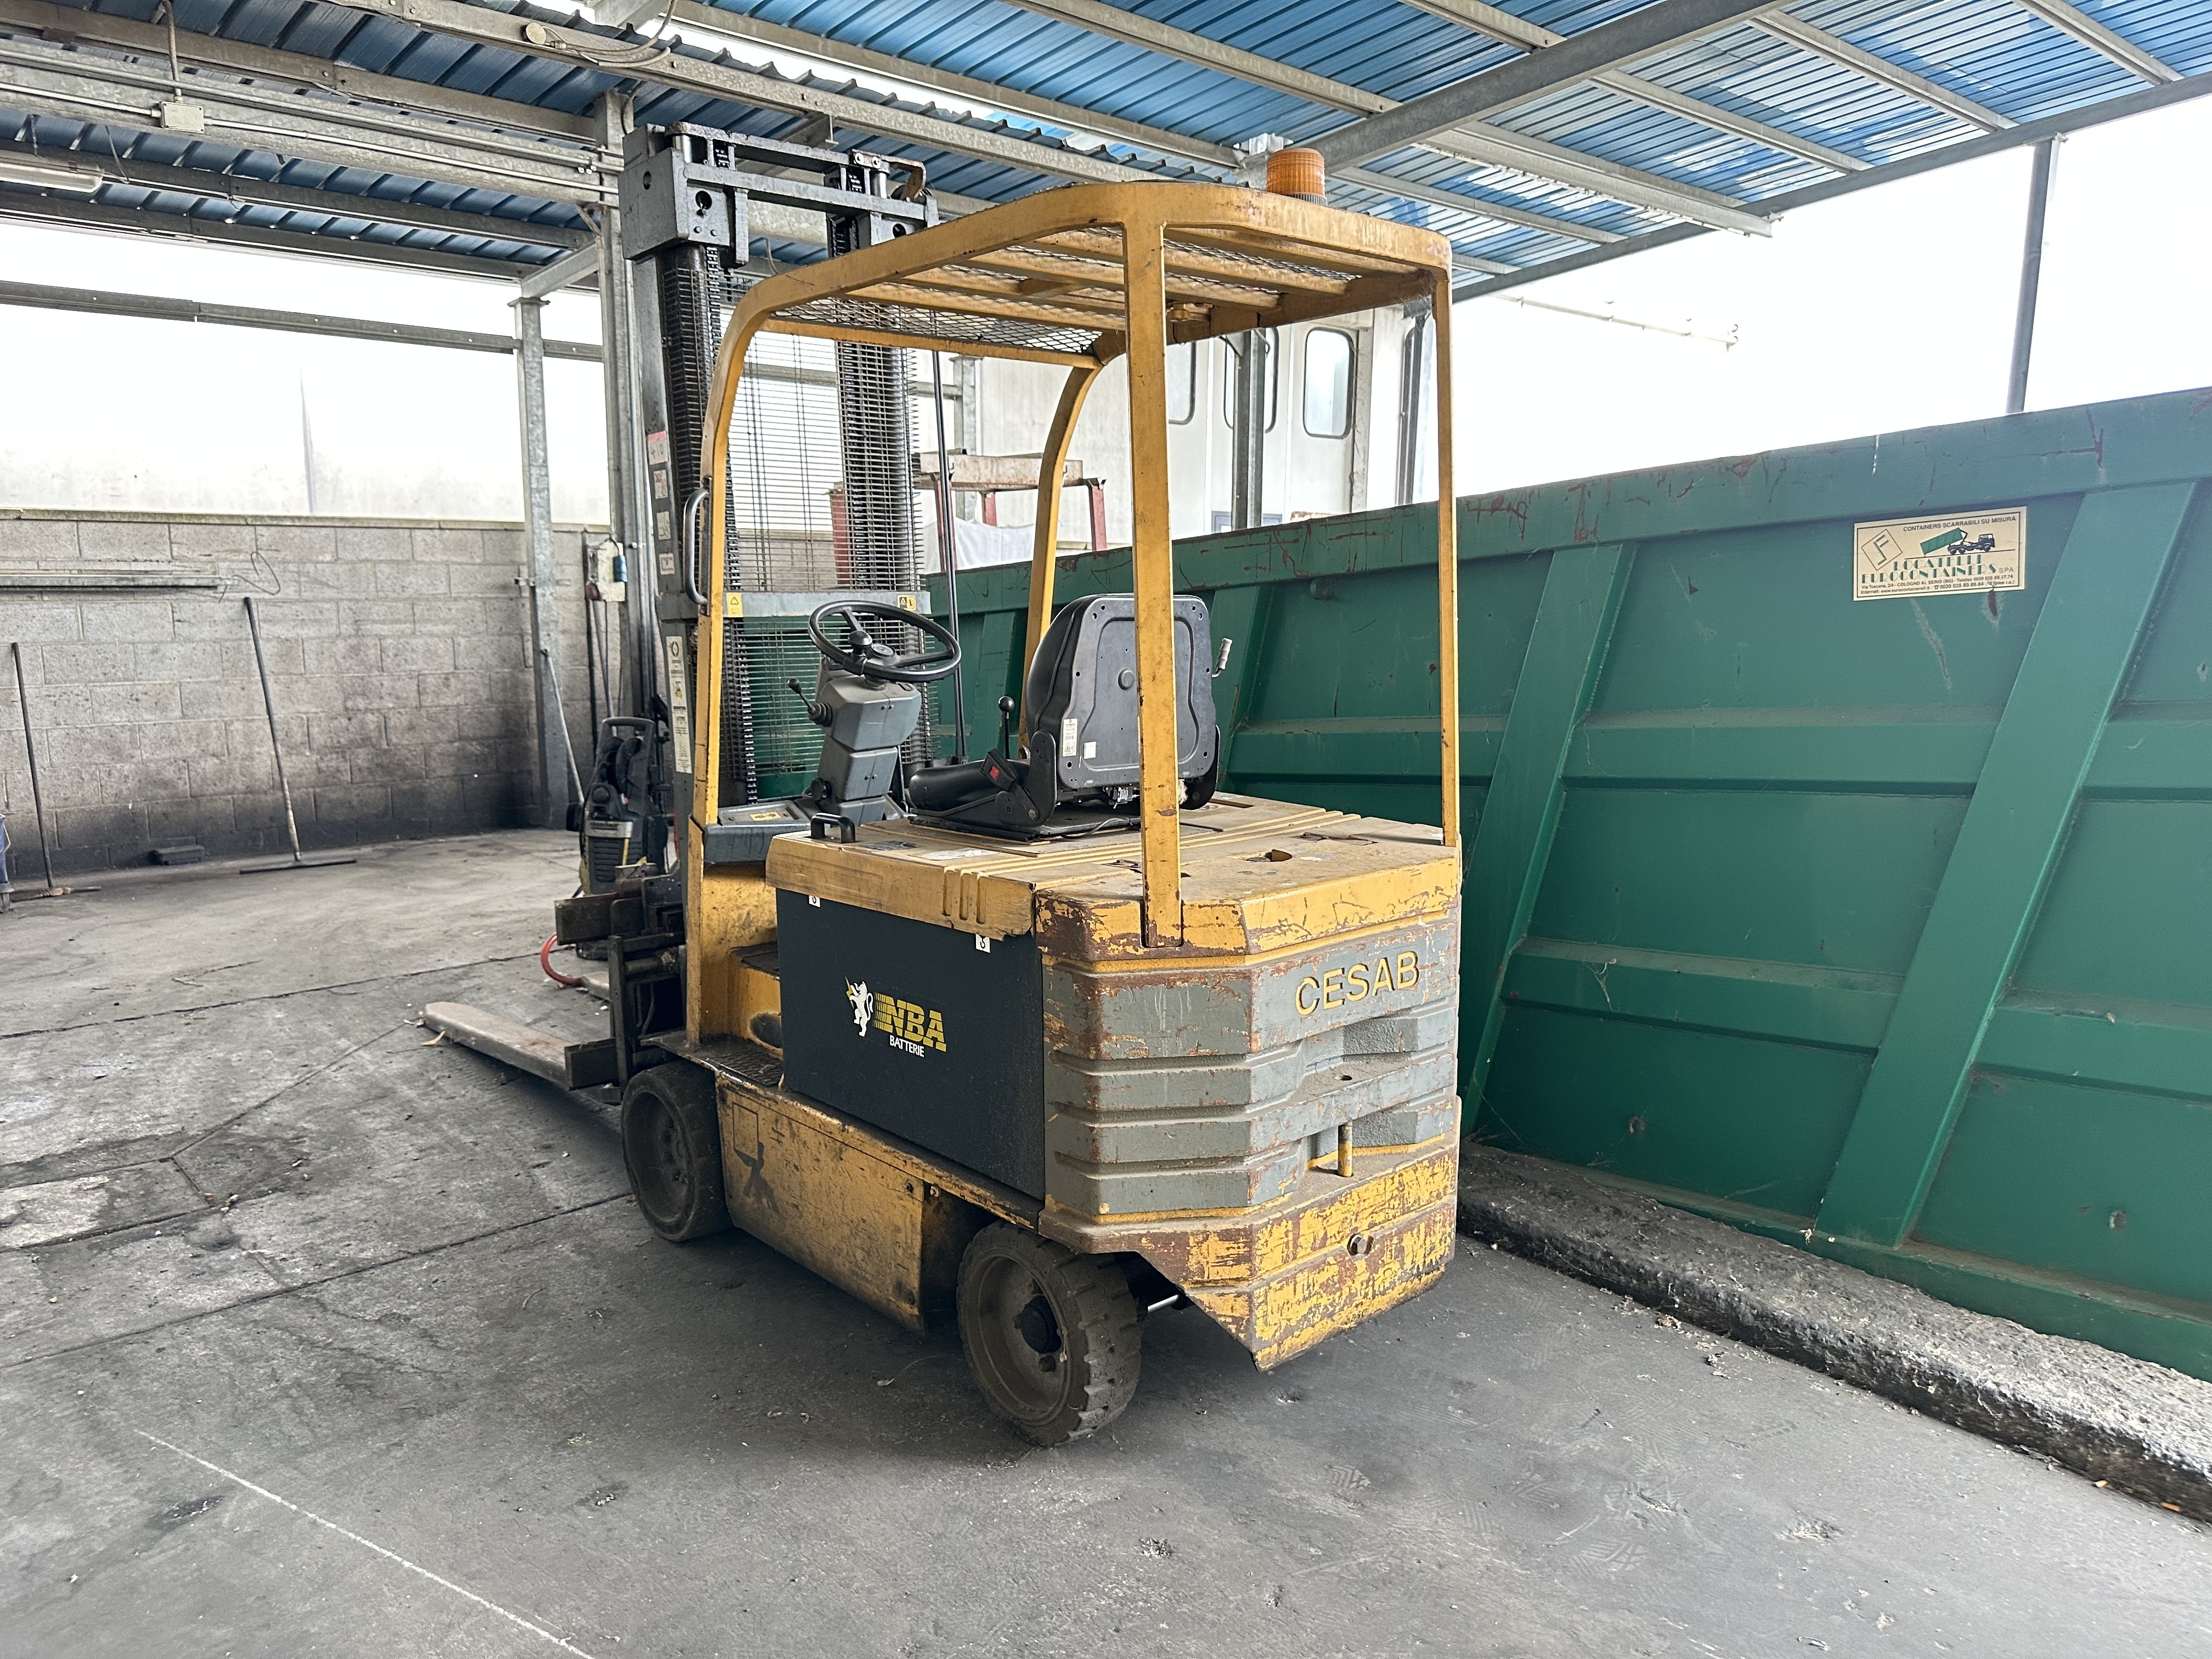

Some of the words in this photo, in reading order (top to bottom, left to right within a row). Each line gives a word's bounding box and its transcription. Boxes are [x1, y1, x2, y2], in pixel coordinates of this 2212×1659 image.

[1903, 523, 1942, 532] CONTAINERS
[1943, 519, 1980, 528] SCARRABILI
[1861, 563, 1997, 584] EUROCONTAINERS
[1894, 554, 1982, 571] LOCATELLI
[1296, 951, 1419, 1015] CESAB
[873, 991, 946, 1052] NBA
[890, 1035, 924, 1058] BATTERIE
